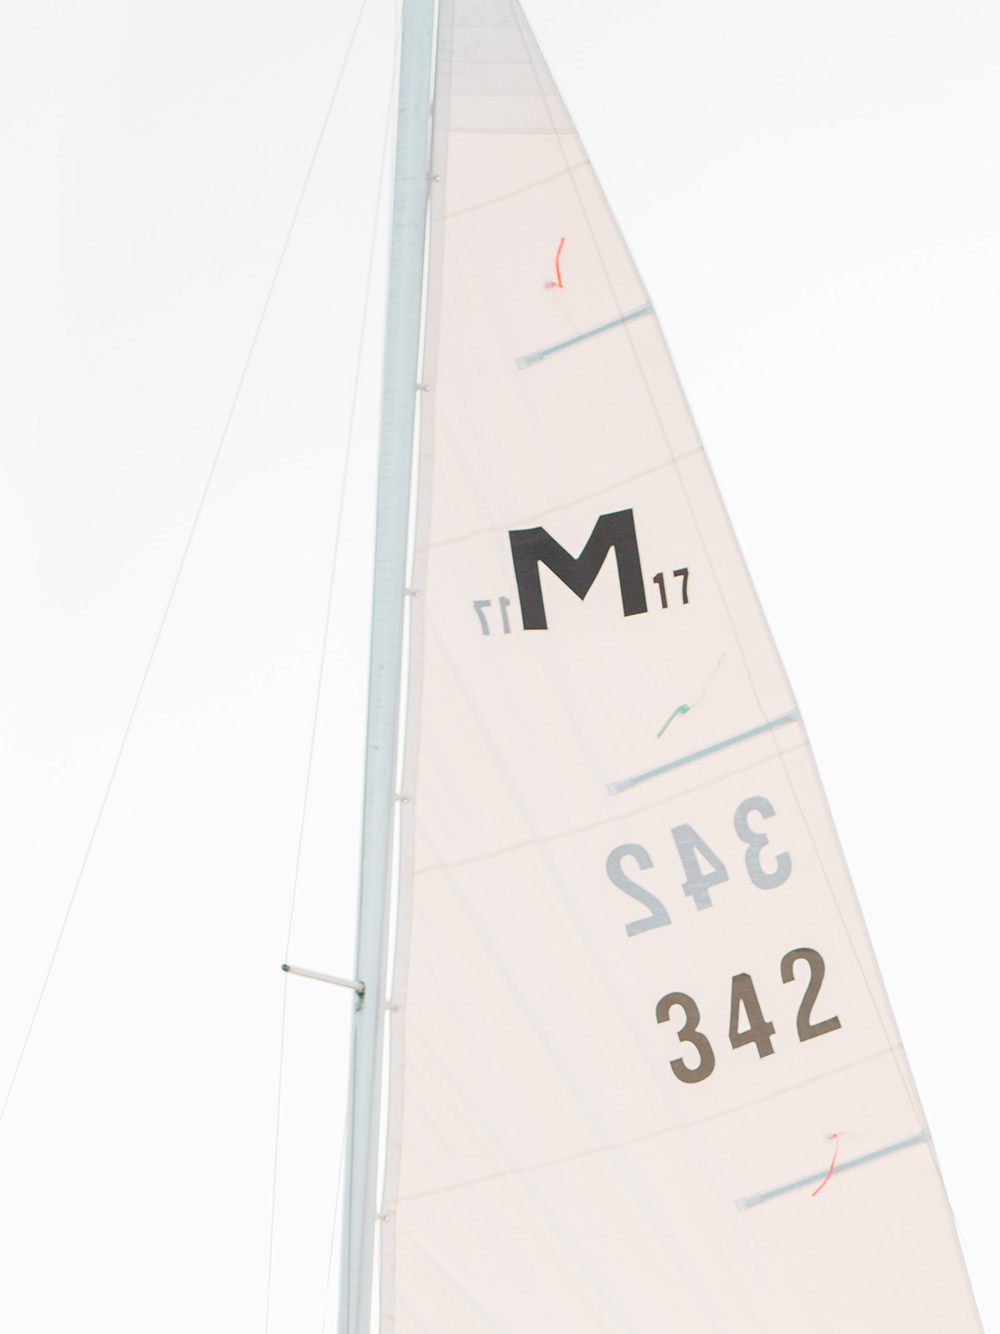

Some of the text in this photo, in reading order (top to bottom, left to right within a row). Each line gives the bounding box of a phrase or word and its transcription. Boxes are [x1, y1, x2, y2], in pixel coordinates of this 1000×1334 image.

[509, 508, 690, 631] M 17
[655, 947, 842, 1085] 342
